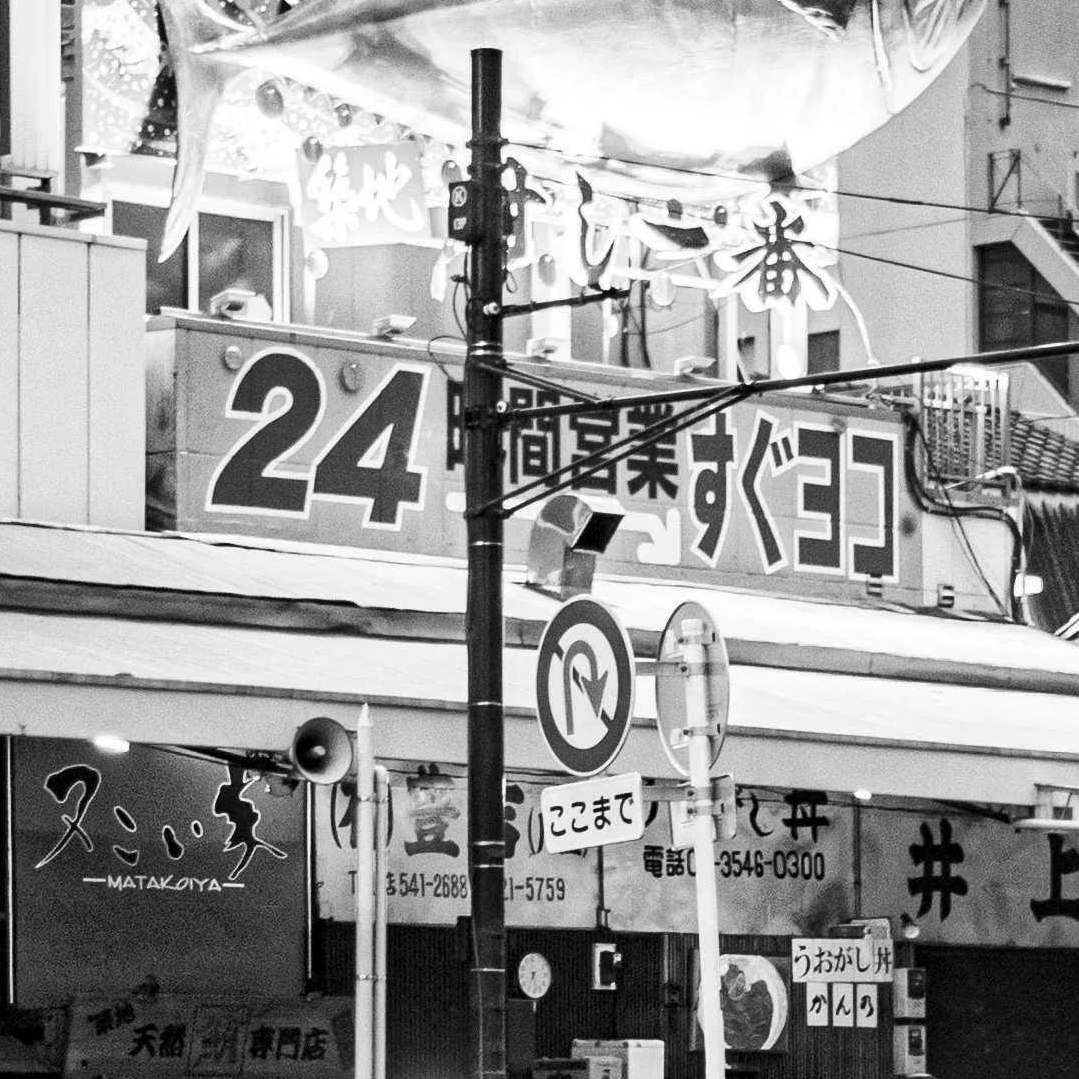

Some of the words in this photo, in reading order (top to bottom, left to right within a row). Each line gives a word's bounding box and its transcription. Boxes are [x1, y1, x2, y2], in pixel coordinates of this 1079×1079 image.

[304, 150, 424, 242] 築地
[688, 402, 900, 585] すぐヨコ
[549, 791, 635, 837] ここまで
[107, 874, 222, 892] MATAKOIYA
[642, 844, 826, 881] 電話0-3546-0300
[808, 993, 875, 1018] かんの
